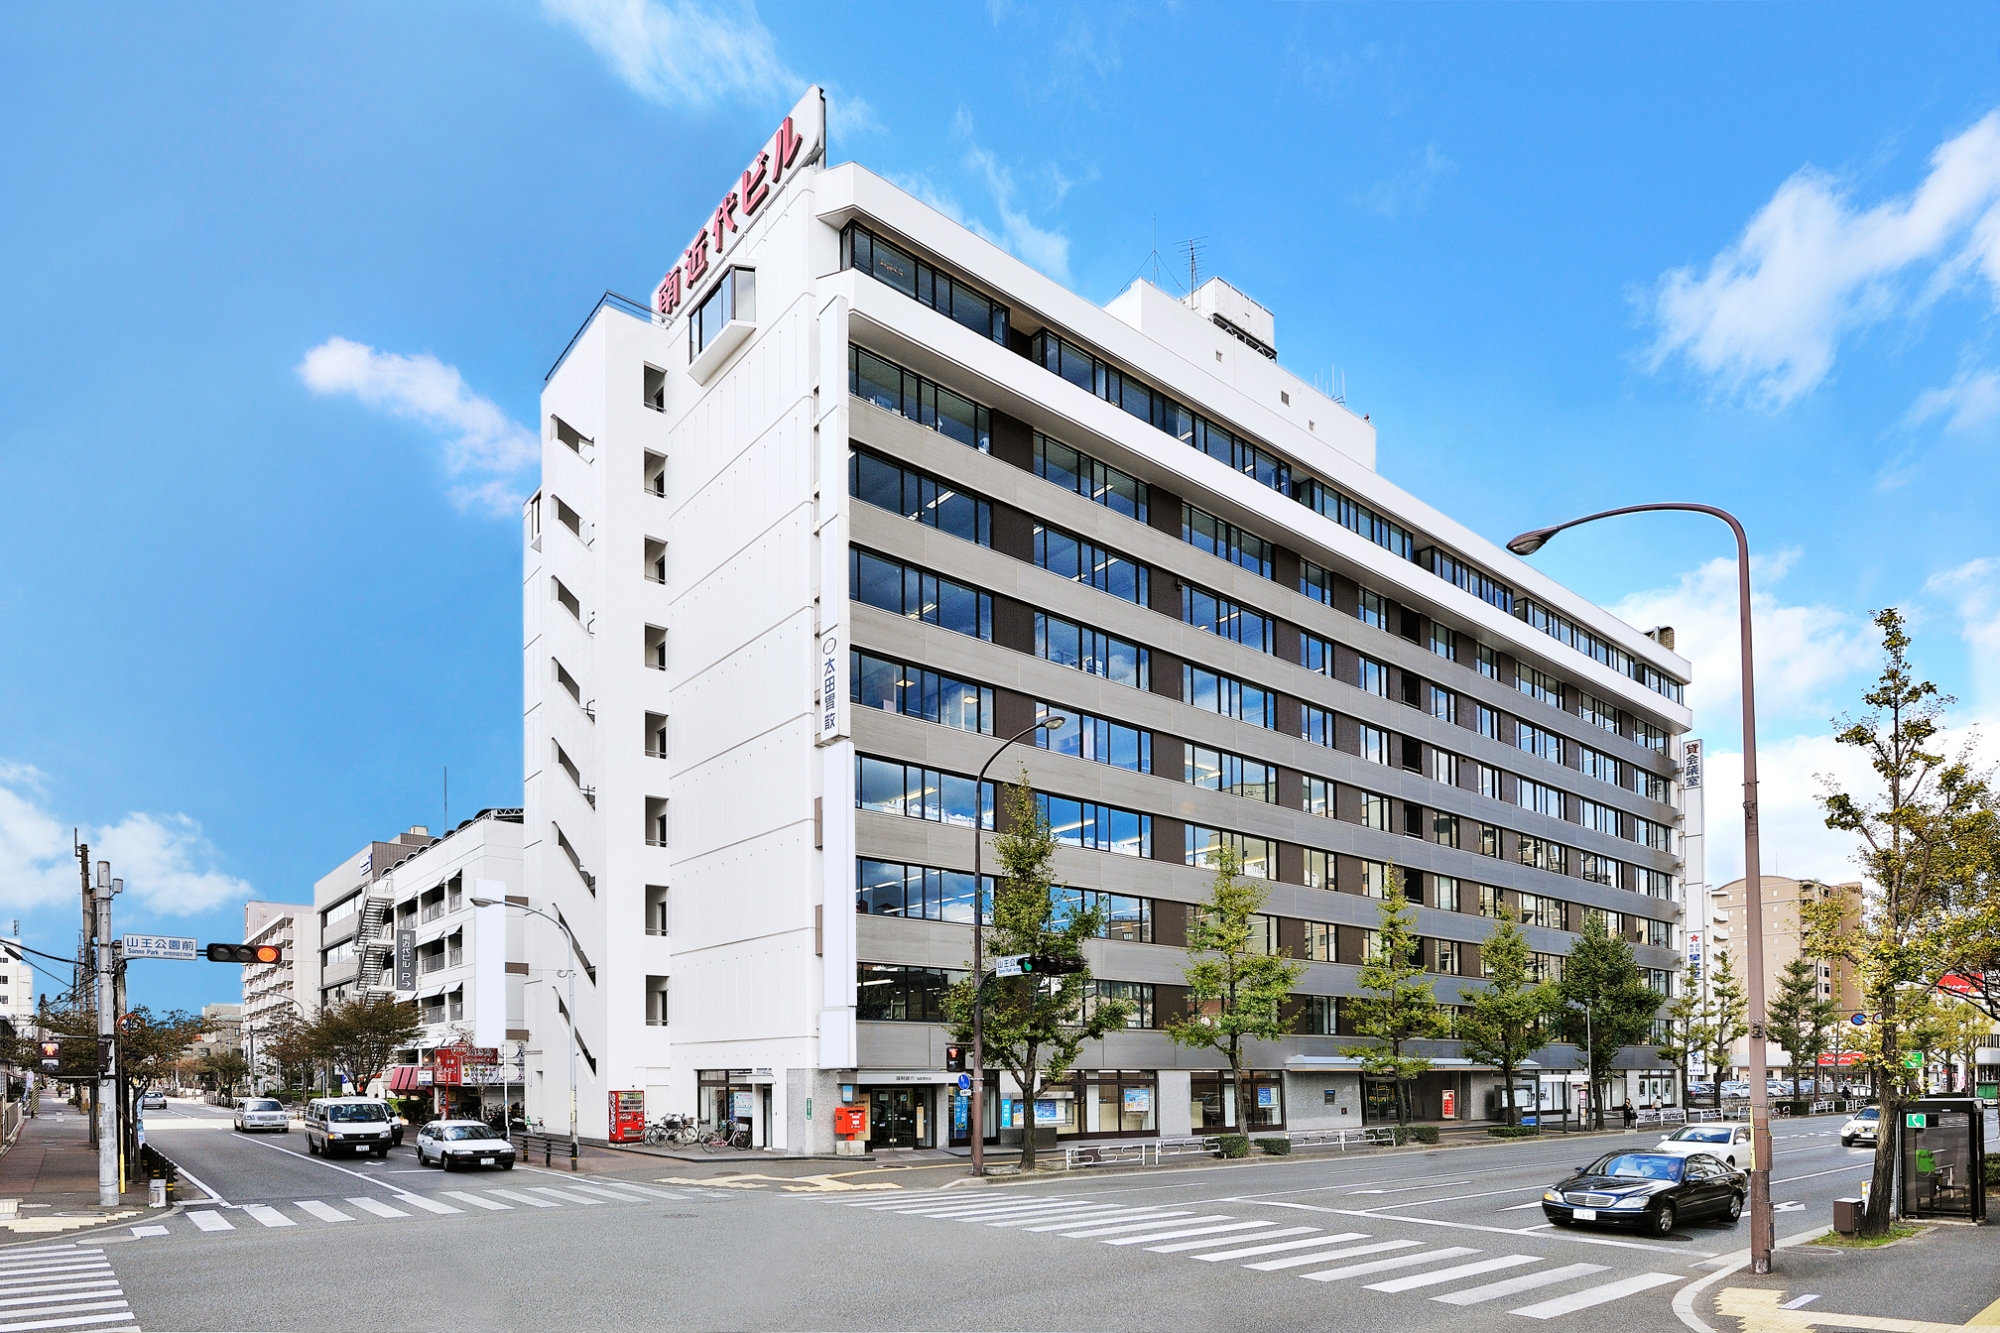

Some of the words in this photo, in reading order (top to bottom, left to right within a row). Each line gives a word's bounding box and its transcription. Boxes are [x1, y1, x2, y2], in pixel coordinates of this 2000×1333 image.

[657, 116, 803, 315] 南近代ビル
[1686, 743, 1699, 787] 貸会議室
[126, 937, 194, 951] 山王公園前
[402, 933, 411, 968] 南近代ビル
[402, 972, 411, 981] P
